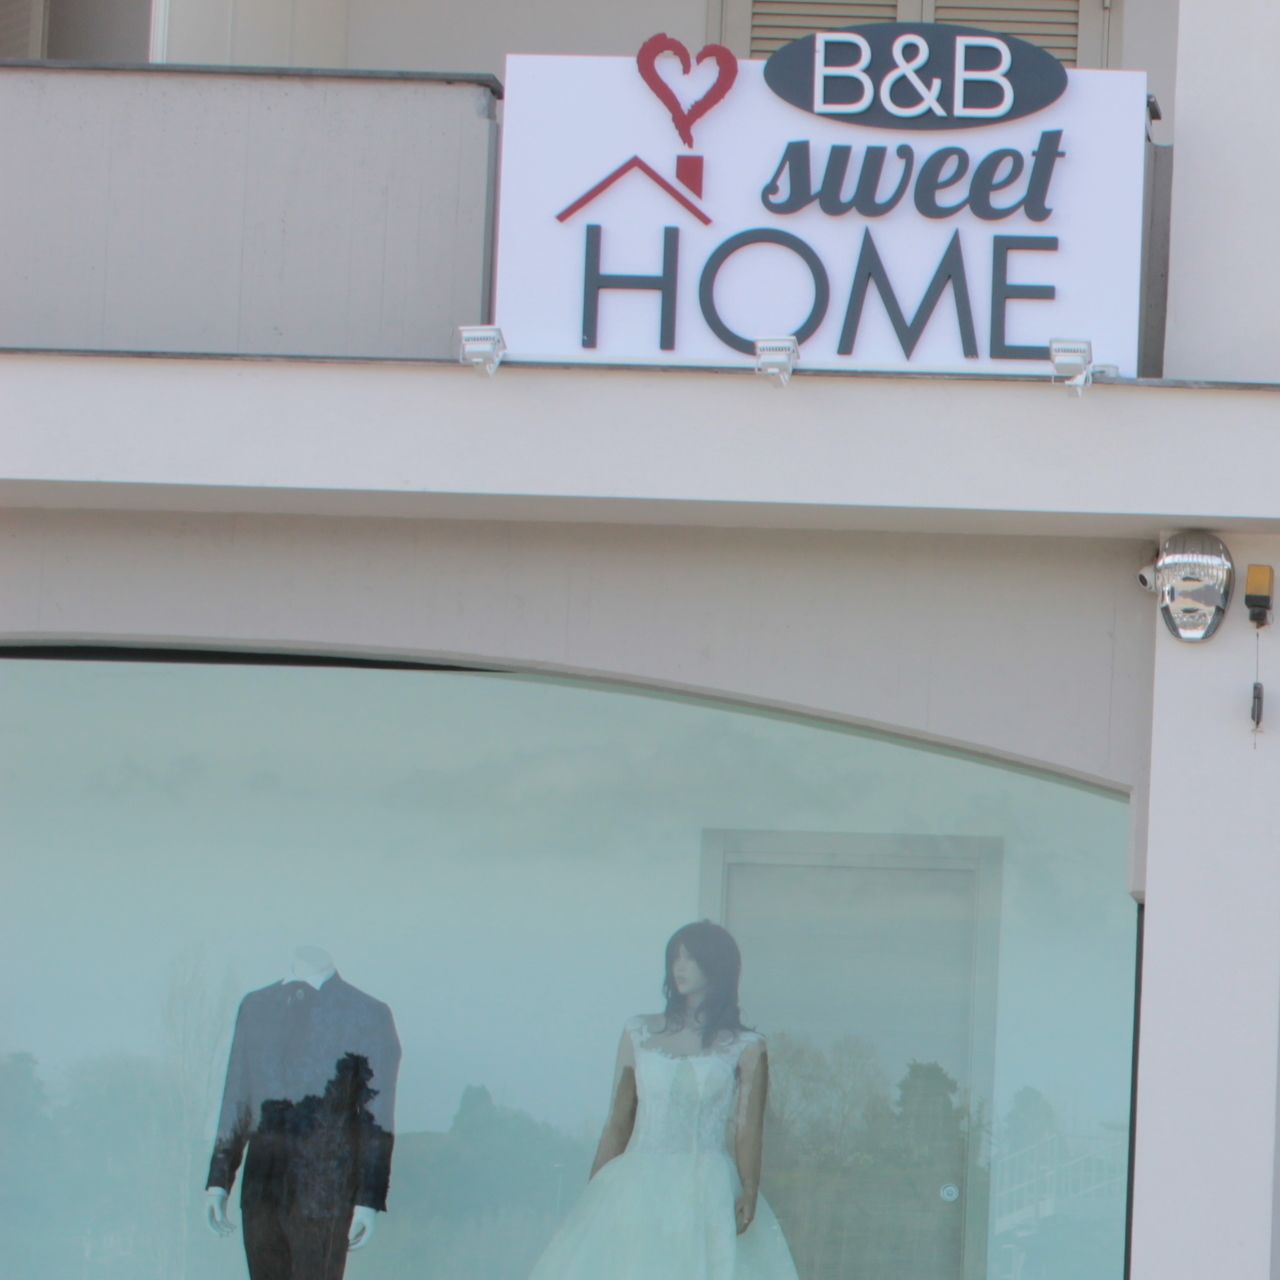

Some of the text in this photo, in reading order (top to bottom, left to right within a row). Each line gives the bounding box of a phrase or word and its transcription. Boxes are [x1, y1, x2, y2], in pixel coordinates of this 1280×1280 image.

[813, 32, 1014, 119] B&B
[761, 130, 1065, 222] sweet
[582, 224, 1059, 361] HOME
